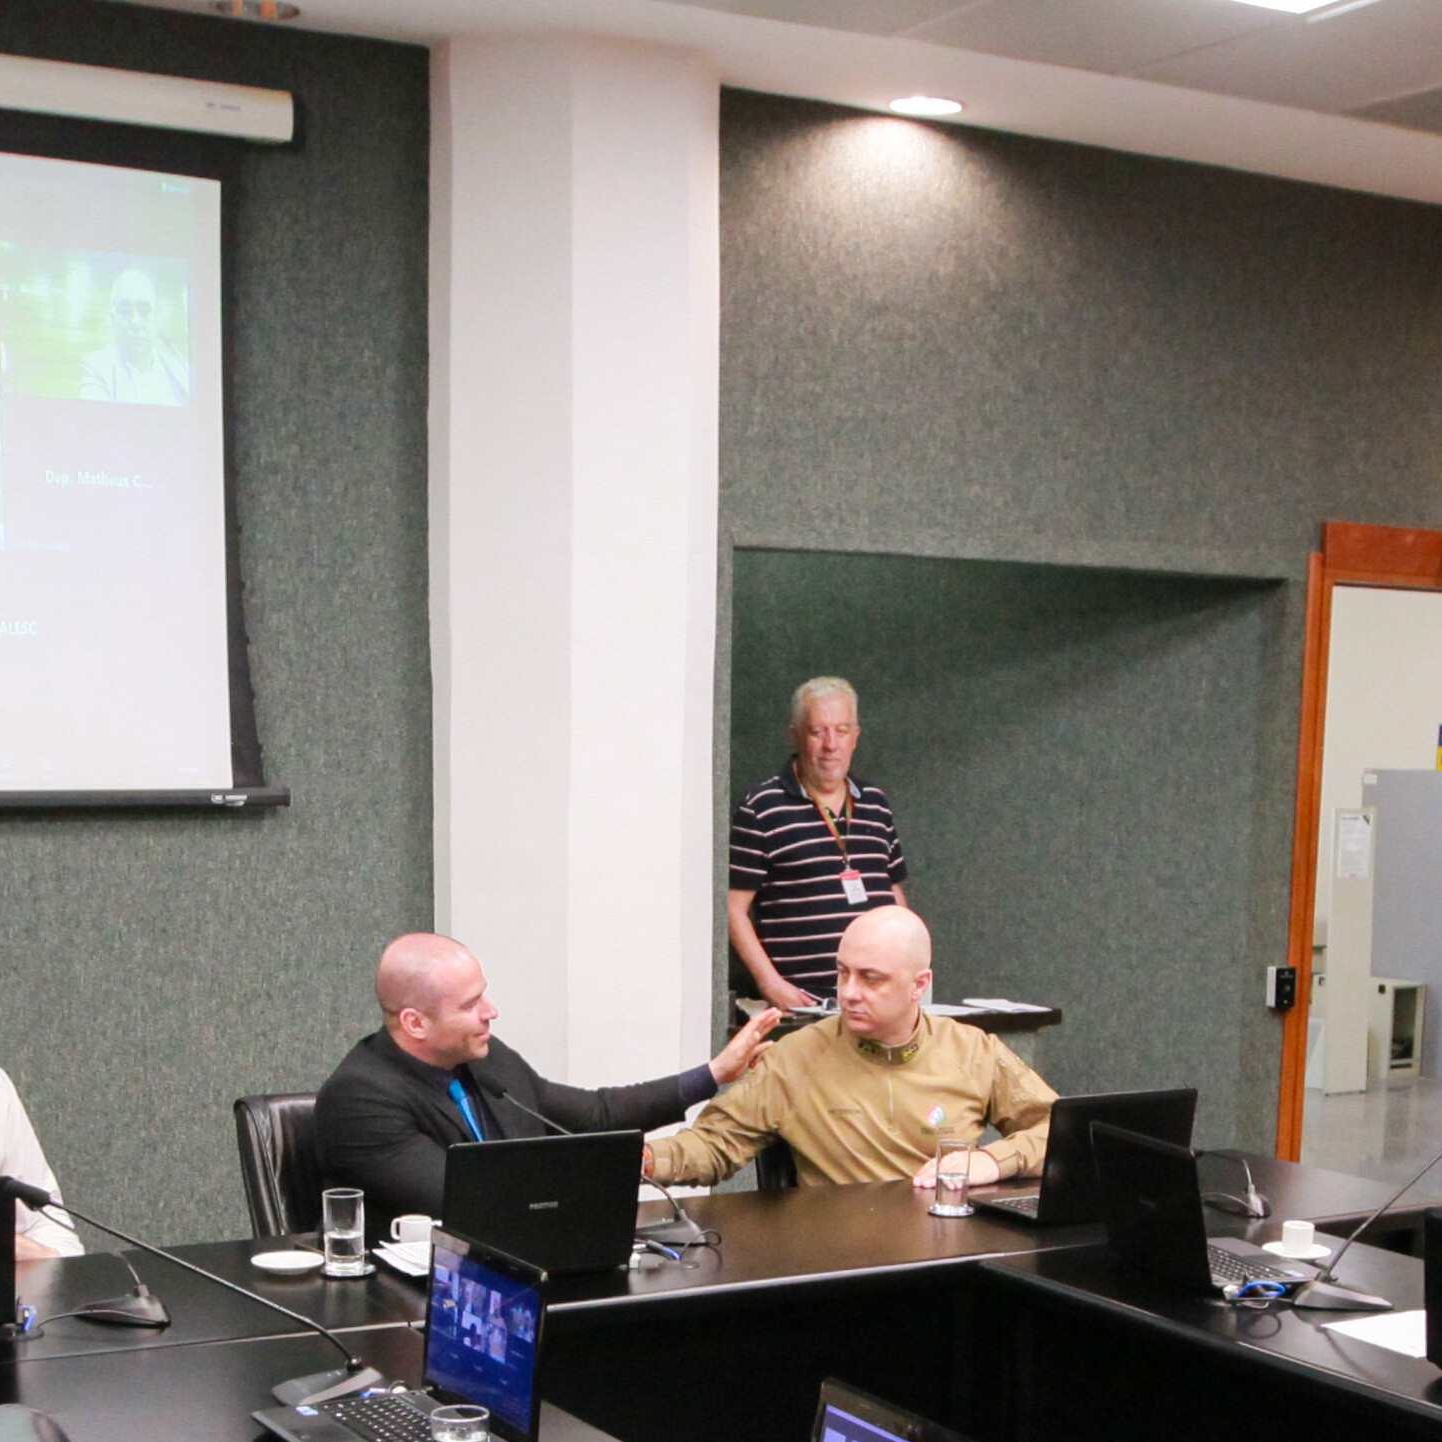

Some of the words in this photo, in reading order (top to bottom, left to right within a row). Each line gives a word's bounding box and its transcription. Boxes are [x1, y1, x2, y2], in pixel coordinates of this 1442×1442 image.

[45, 469, 74, 488] Dep.
[77, 470, 130, 487] Matheus
[0, 620, 38, 636] ALESC
